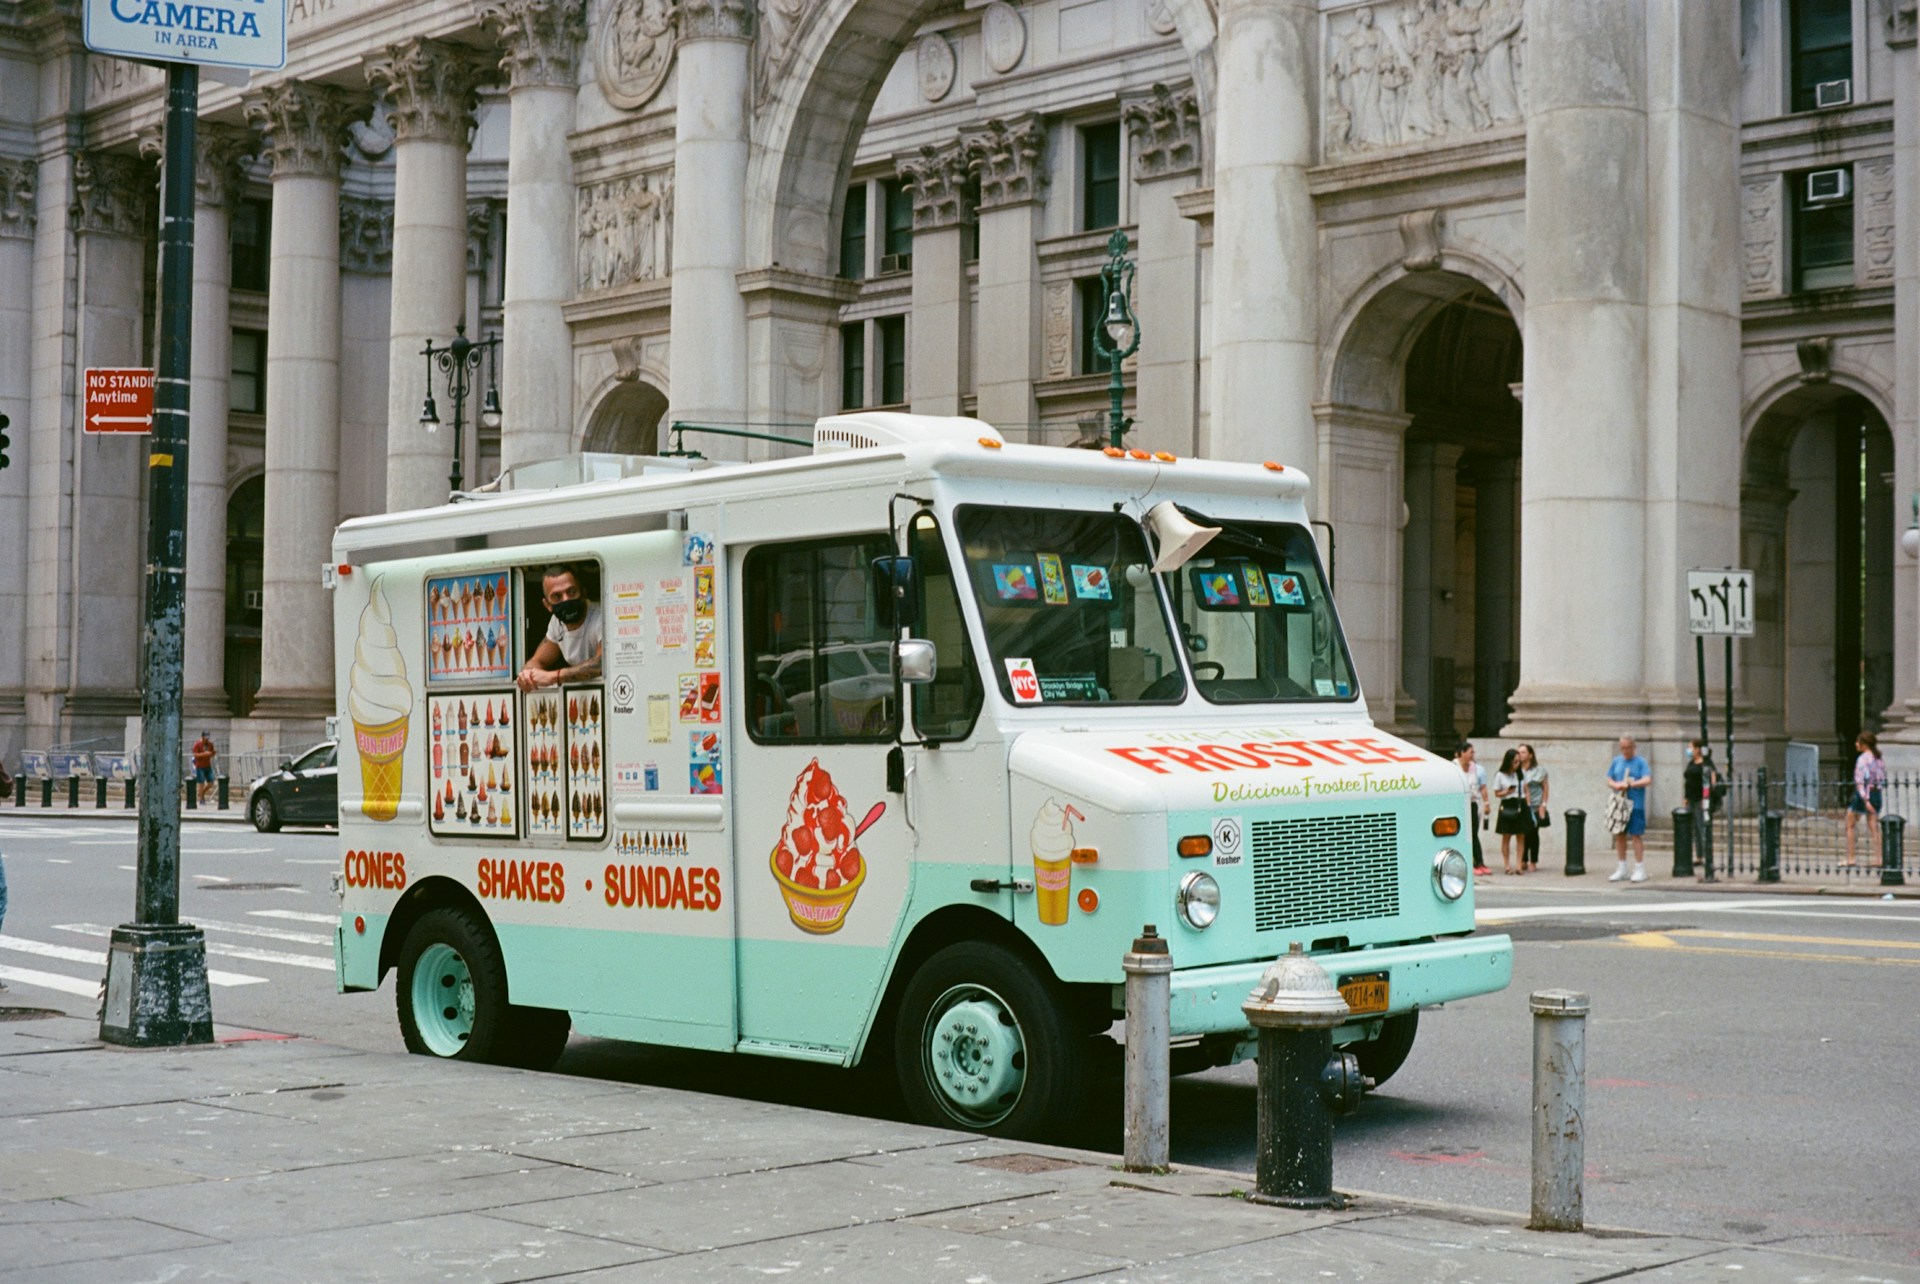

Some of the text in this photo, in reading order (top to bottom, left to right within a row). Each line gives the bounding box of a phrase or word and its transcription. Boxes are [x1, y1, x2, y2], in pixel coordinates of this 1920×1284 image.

[109, 0, 261, 38] CAMERA
[154, 30, 219, 50] IN AREA
[90, 375, 107, 388] NO
[89, 390, 138, 406] Anytime
[620, 685, 627, 695] K
[1012, 675, 1037, 691] NYC
[613, 705, 634, 714] Kosher
[357, 728, 405, 756] FUN-TIME
[1104, 738, 1426, 775] FROSTEE
[1211, 771, 1422, 803] Delicious Frostee Treats
[1223, 830, 1231, 843] K
[345, 850, 407, 890] CONES
[1216, 855, 1241, 866] Kosher
[477, 858, 722, 911] SHAKES SUNDAES
[788, 897, 847, 923] FUN-TIME
